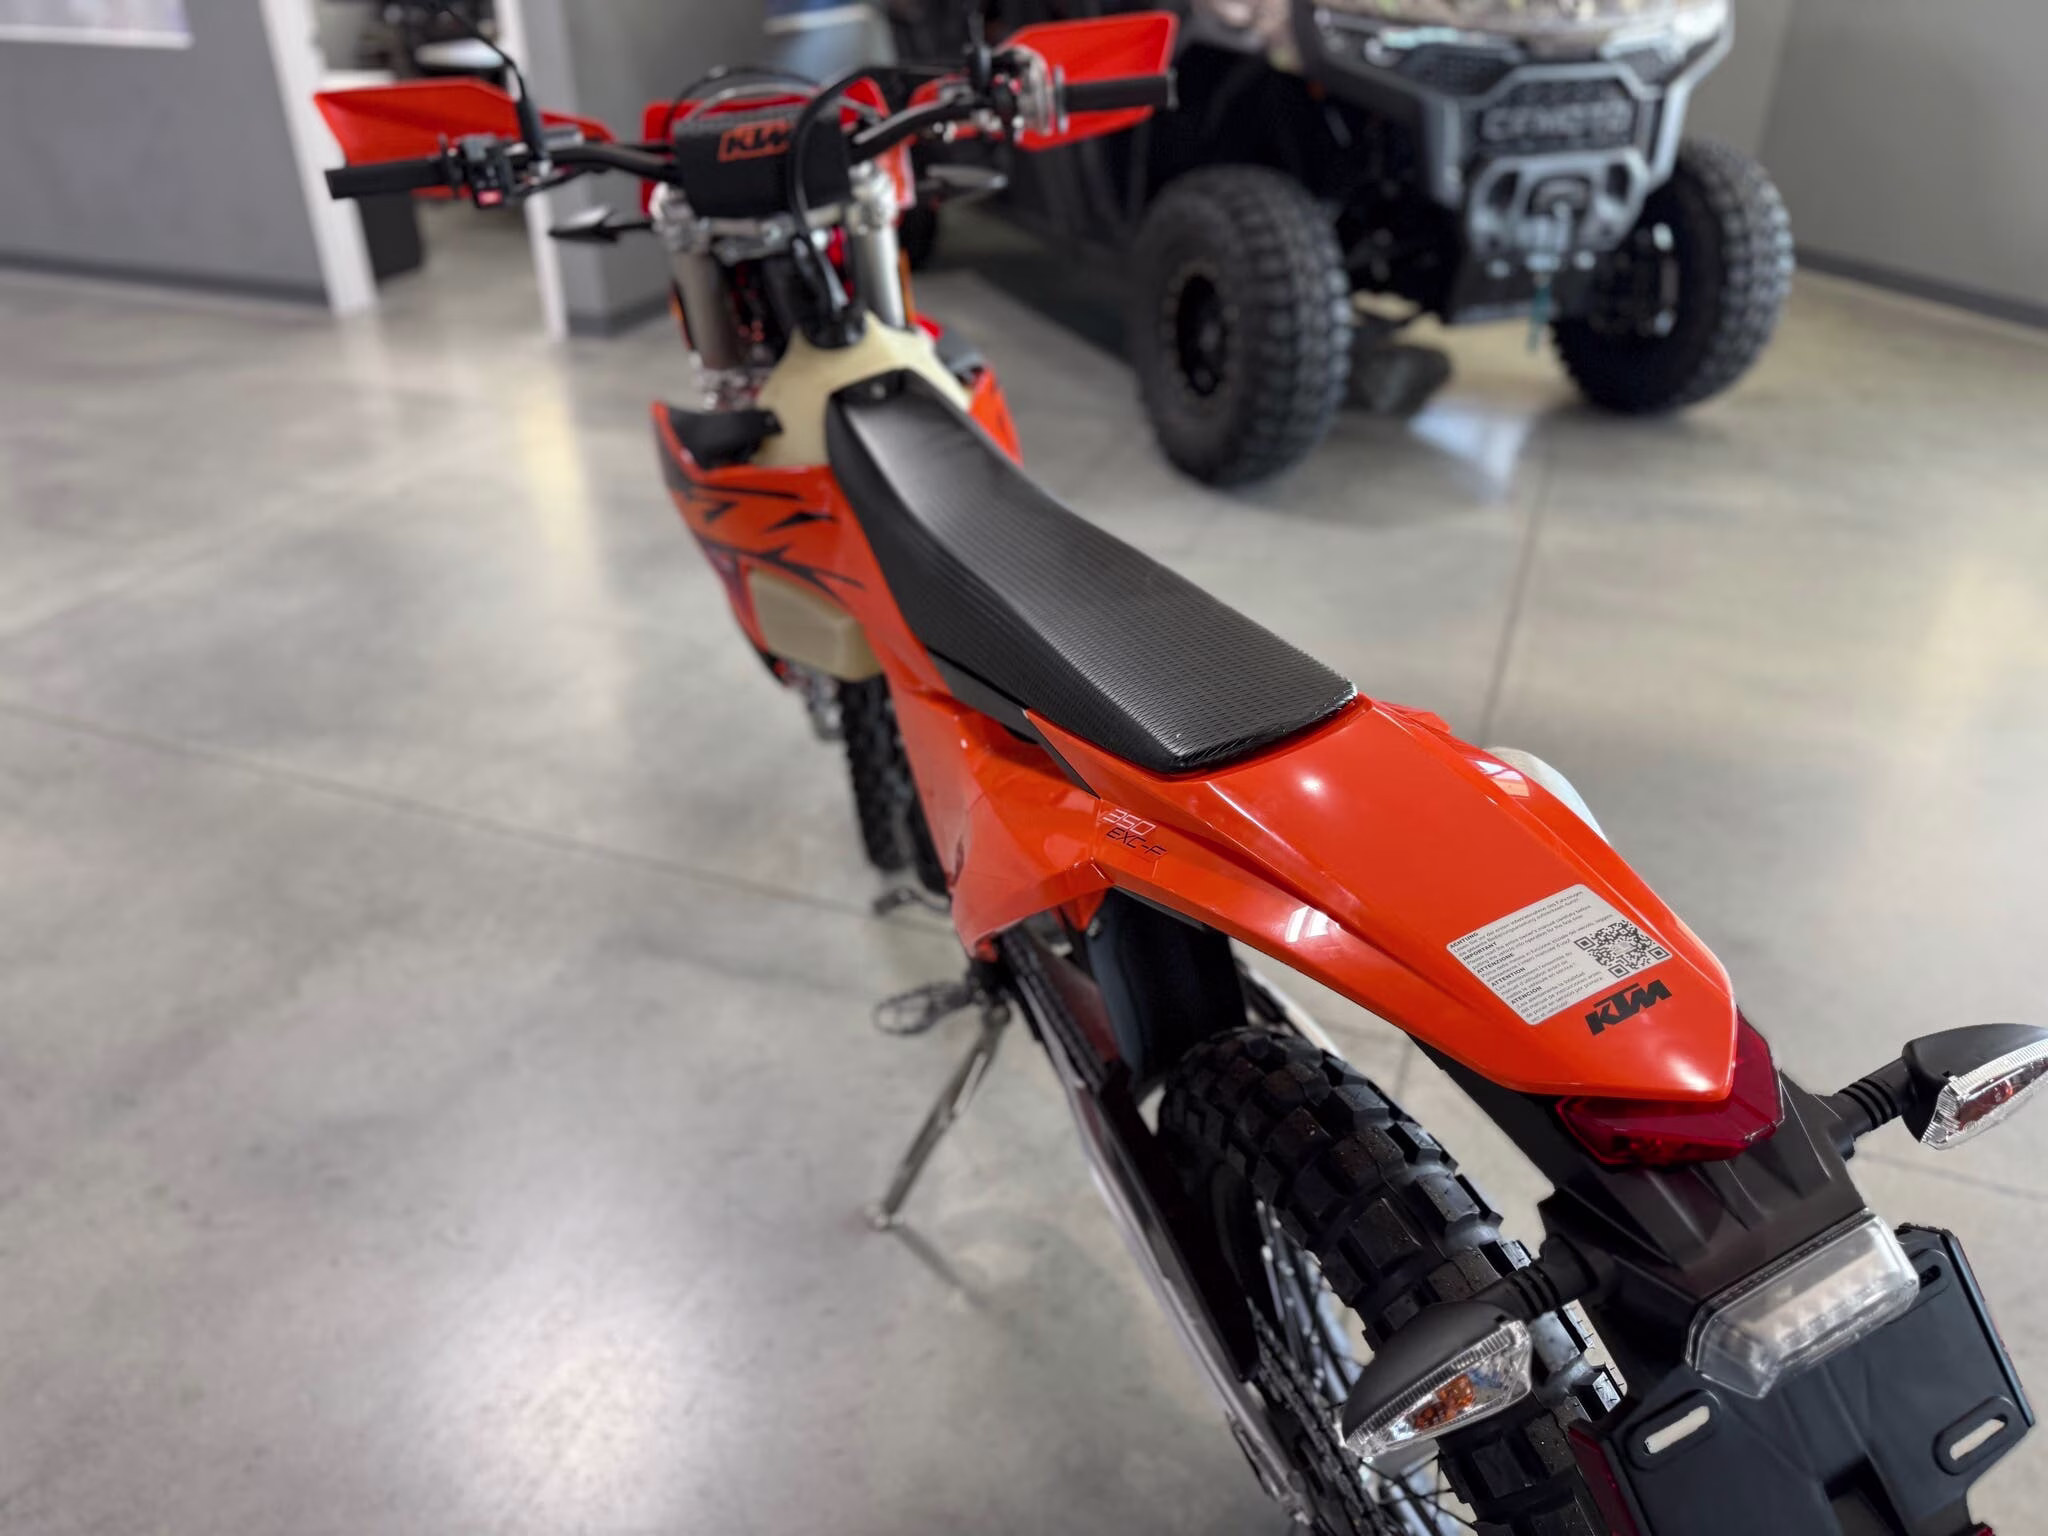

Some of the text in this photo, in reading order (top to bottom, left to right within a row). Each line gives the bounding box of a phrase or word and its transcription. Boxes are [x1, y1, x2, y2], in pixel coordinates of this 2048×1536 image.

[1102, 808, 1157, 836] 350
[1106, 826, 1168, 856] EXC-F
[1450, 932, 1478, 948] ACHTUNG
[1463, 941, 1497, 961] IMPORTANT
[1477, 953, 1514, 973] ATTENZIONE
[1490, 967, 1526, 987] ATTENTION
[1584, 979, 1673, 1036] KTM
